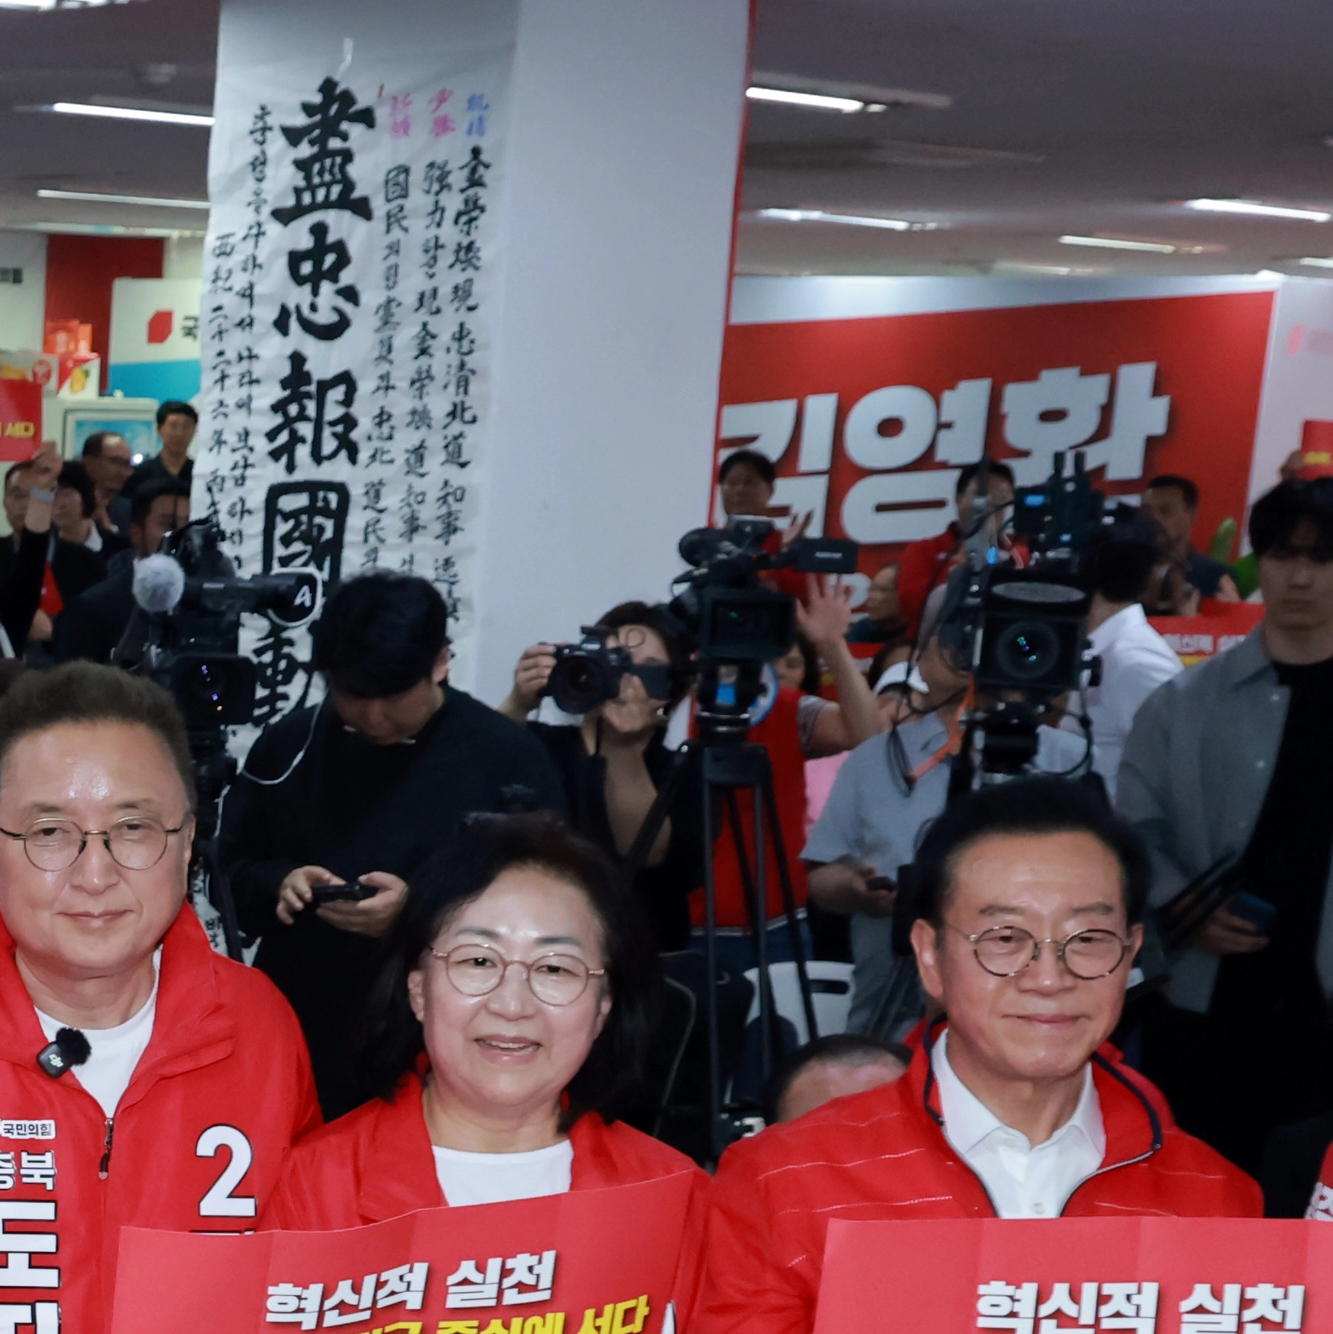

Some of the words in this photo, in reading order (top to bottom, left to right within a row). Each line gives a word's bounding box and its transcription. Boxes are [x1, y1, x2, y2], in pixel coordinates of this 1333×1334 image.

[2, 1122, 53, 1137] 국민의힘
[193, 1123, 259, 1218] 2
[264, 1260, 430, 1332] 혁신적
[444, 1249, 558, 1310] 실천
